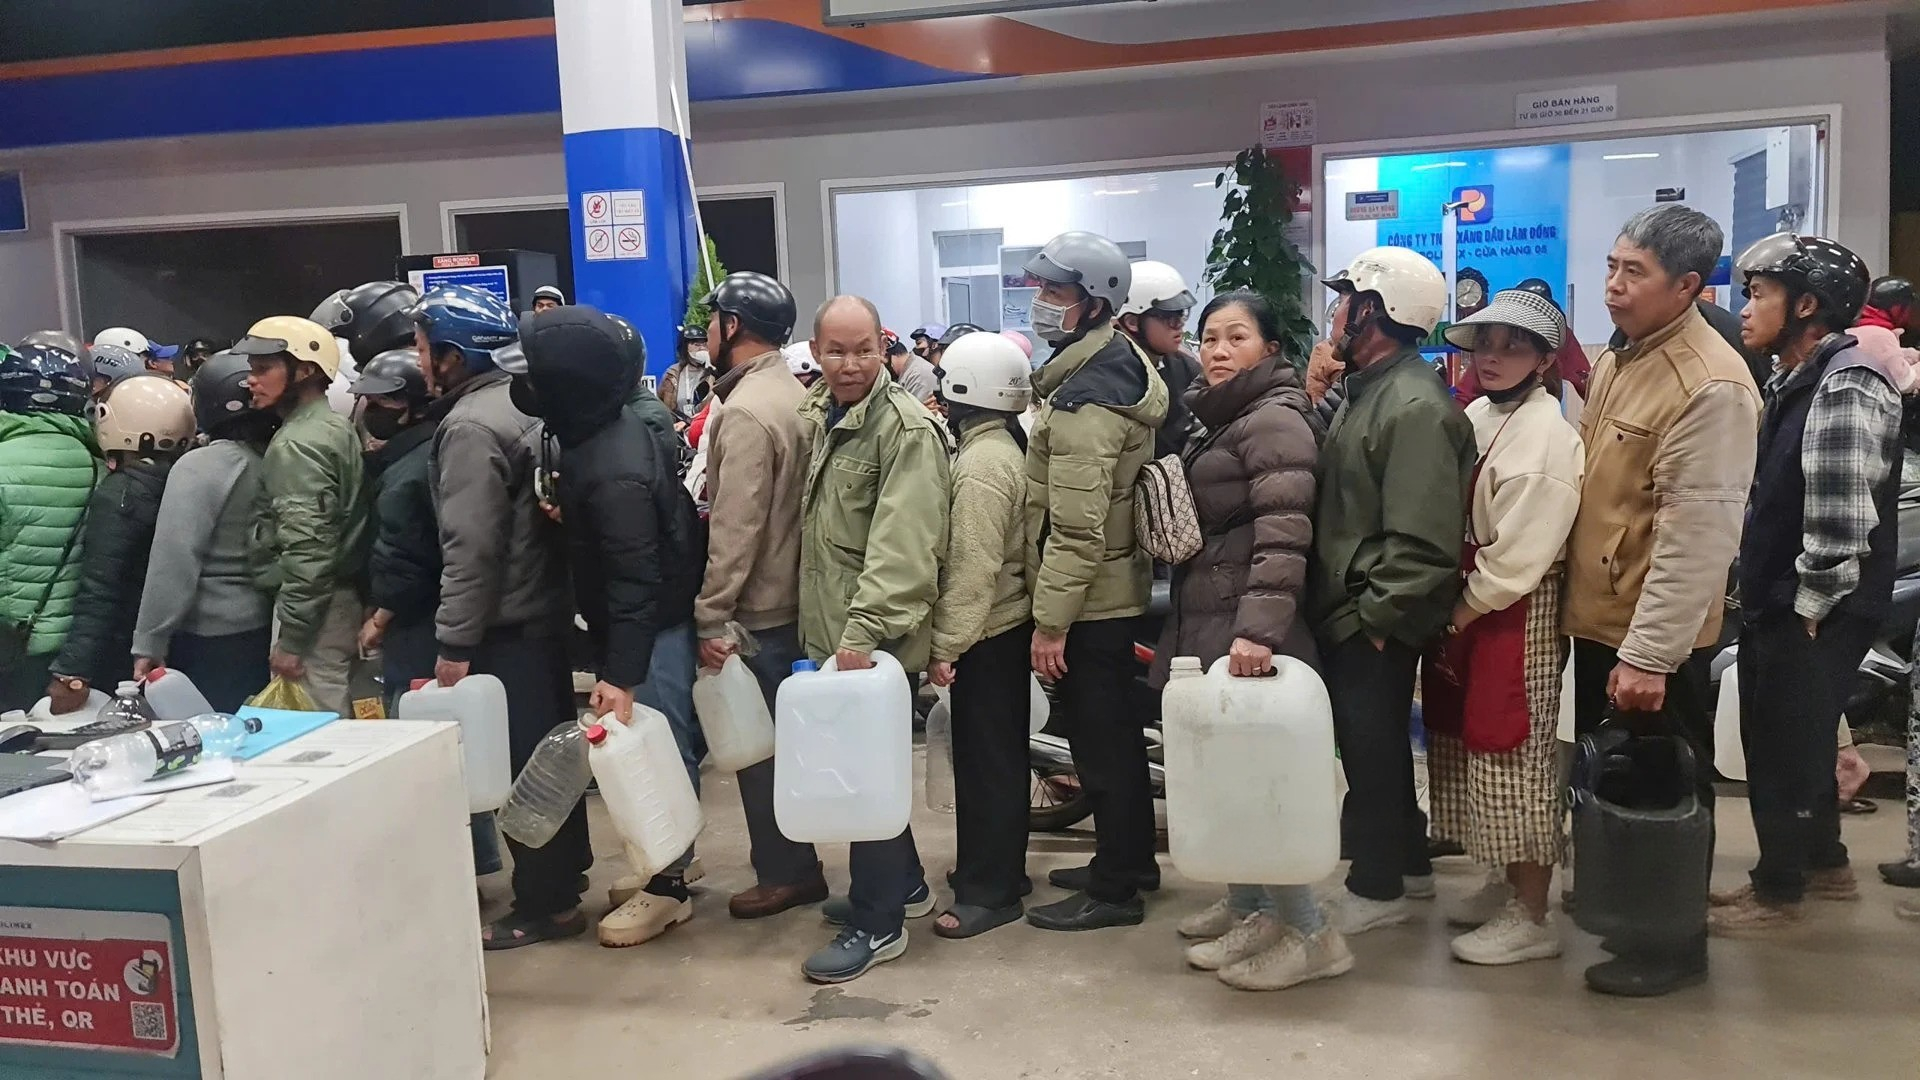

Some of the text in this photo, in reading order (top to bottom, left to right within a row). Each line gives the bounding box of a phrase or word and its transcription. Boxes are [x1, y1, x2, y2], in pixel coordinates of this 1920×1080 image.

[1551, 97, 1571, 107] BÁN
[1573, 95, 1600, 104] HÀNG
[1415, 232, 1428, 247] TY
[1484, 226, 1504, 243] DẦU
[1506, 226, 1528, 241] LÂM
[1529, 223, 1557, 240] ĐỒNG
[1500, 244, 1532, 257] HÀNG
[43, 947, 93, 975] VỰC
[0, 976, 120, 1002] ANH TOÁN
